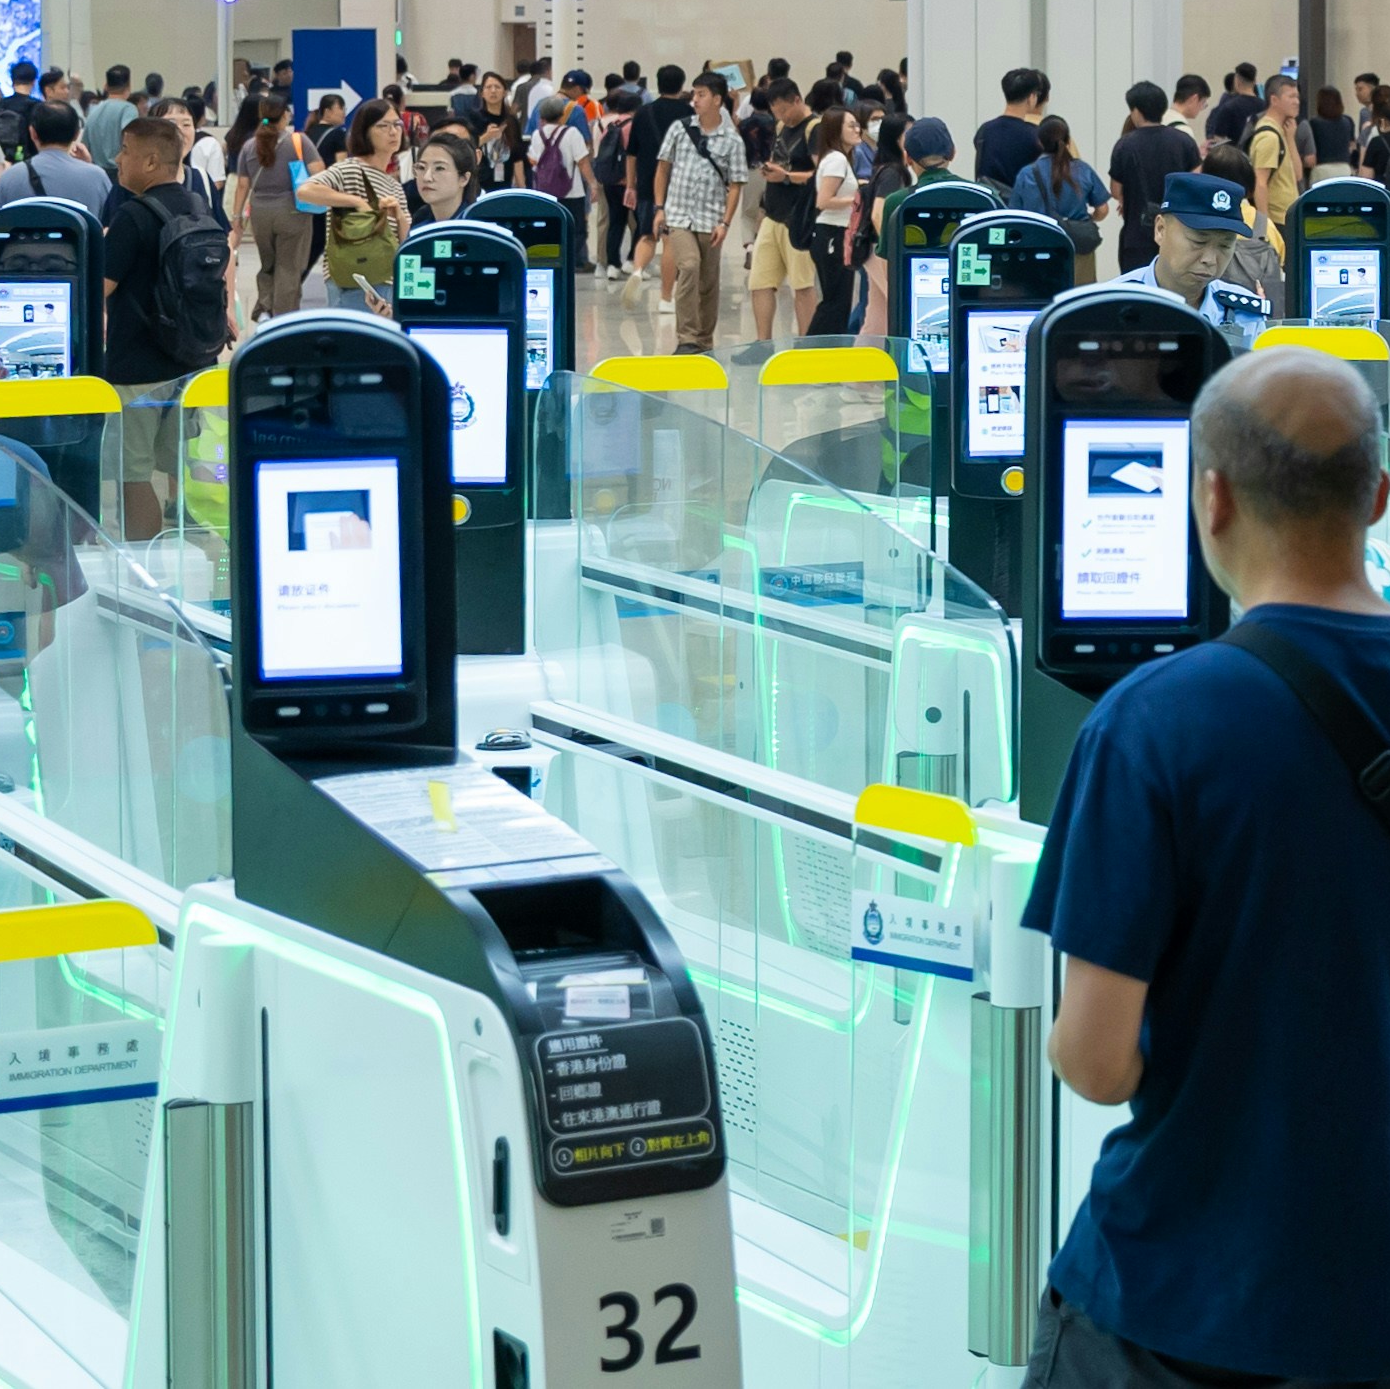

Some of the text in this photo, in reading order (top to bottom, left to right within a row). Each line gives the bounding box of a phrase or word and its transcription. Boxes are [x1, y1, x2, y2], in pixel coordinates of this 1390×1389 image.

[9, 1039, 139, 1066] 入境事務處
[9, 1059, 138, 1082] IMMIGRATION DEPARTMENT
[599, 1282, 701, 1372] 32
